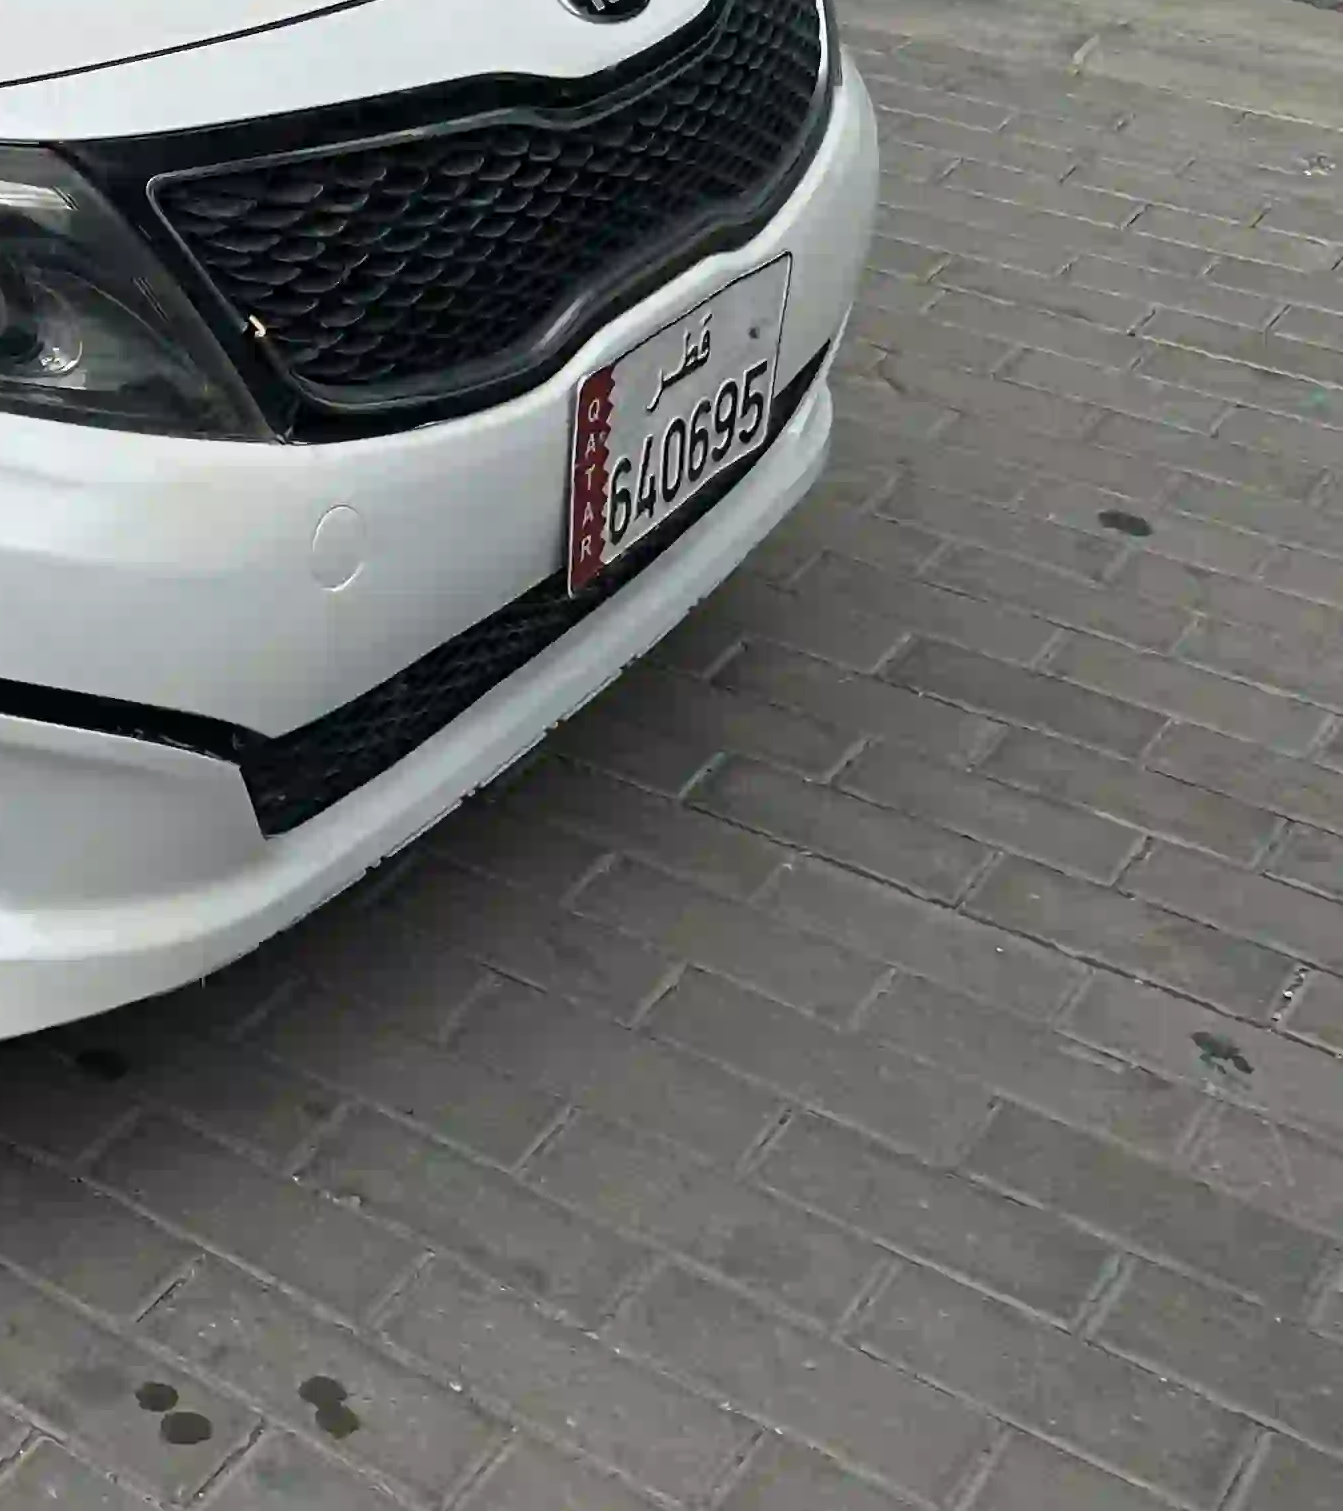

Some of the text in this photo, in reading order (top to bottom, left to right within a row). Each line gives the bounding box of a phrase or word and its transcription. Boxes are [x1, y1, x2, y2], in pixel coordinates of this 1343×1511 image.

[646, 313, 712, 412] قطر
[579, 397, 601, 563] QATAR
[606, 358, 768, 546] 640695
